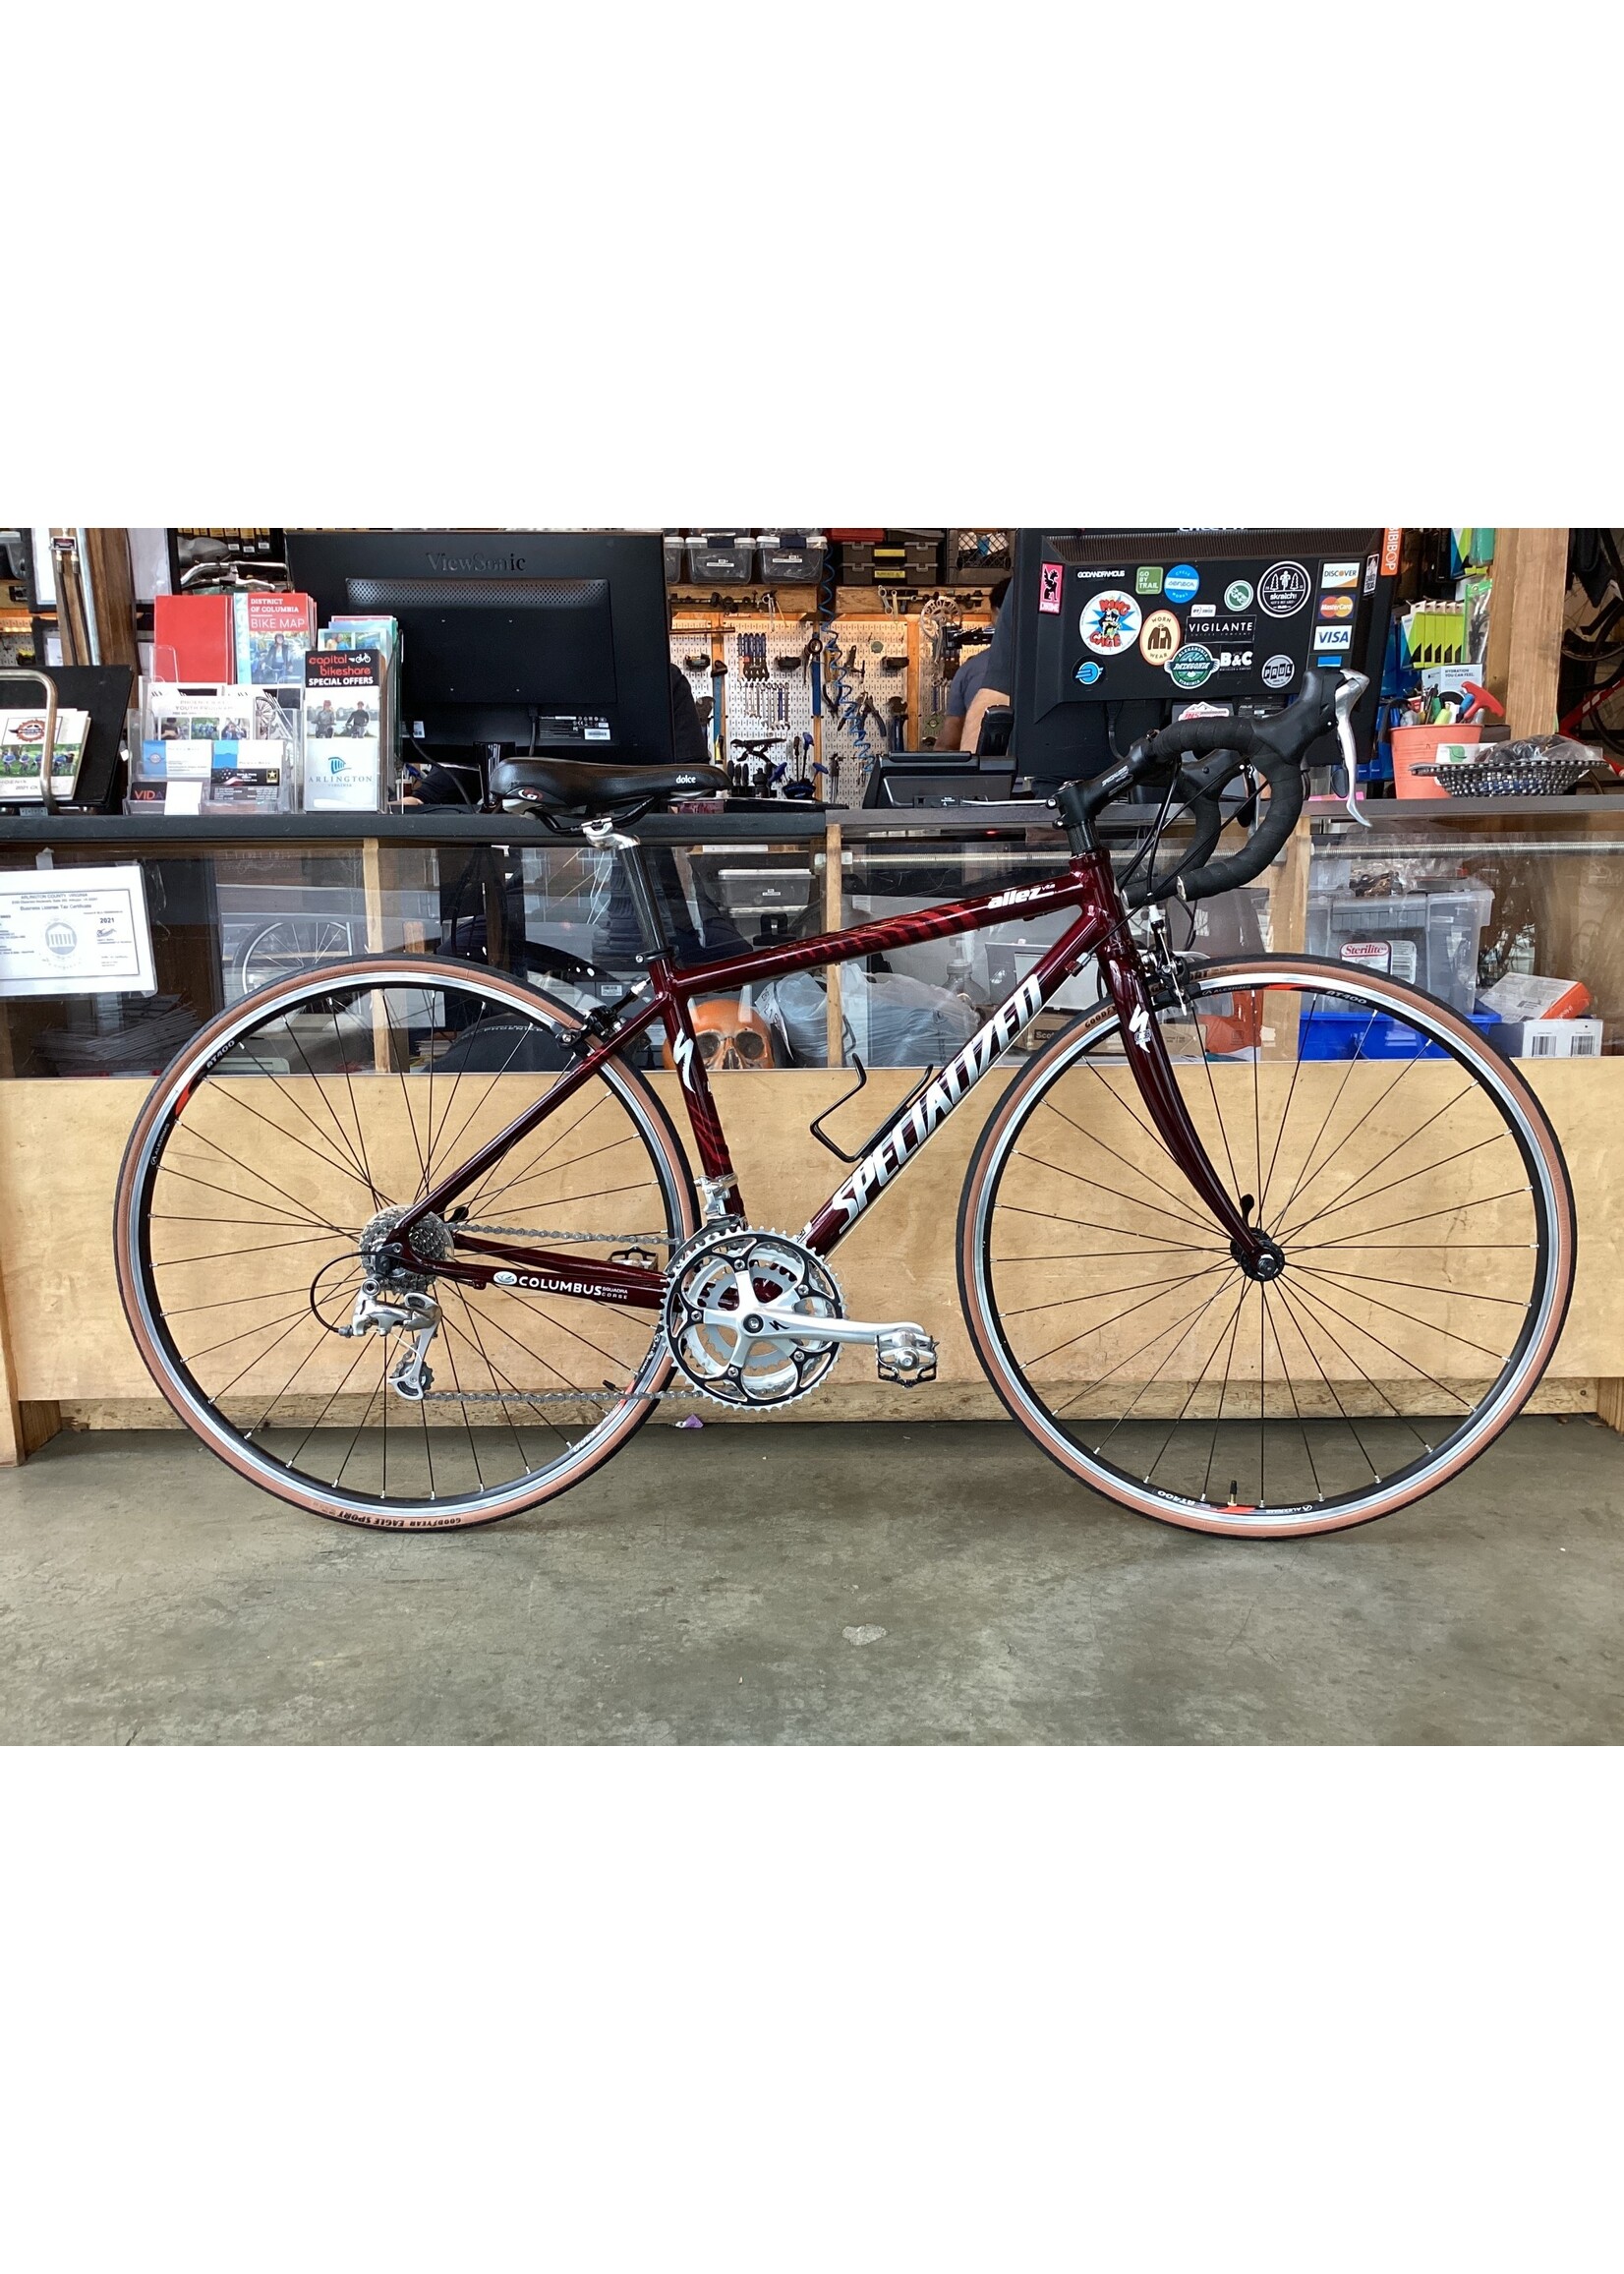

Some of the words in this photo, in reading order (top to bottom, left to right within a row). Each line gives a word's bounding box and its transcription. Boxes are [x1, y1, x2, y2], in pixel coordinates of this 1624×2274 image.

[427, 553, 526, 571] ViewSonic
[1320, 603, 1354, 612] MasterCard
[251, 618, 276, 629] BIKE
[279, 617, 306, 628] MAP
[1189, 622, 1253, 632] VIGILANTE
[1318, 631, 1349, 644] VISA
[309, 654, 347, 666] capital
[1220, 651, 1253, 667] B&C
[319, 666, 371, 676] bikeshare
[309, 676, 341, 686] SPECIAL
[342, 676, 374, 685] OFFERS
[675, 775, 696, 785] dolce
[987, 887, 1054, 909] allez
[1344, 944, 1384, 956] Sterilite
[1214, 984, 1251, 993] ALEXRIMS
[833, 973, 1043, 1235] SPECIALIZED
[518, 1276, 603, 1297] COLUMBUS
[337, 1511, 372, 1524] SPORT
[375, 1517, 404, 1528] EAGLE
[409, 1517, 462, 1527] GOODYEAR
